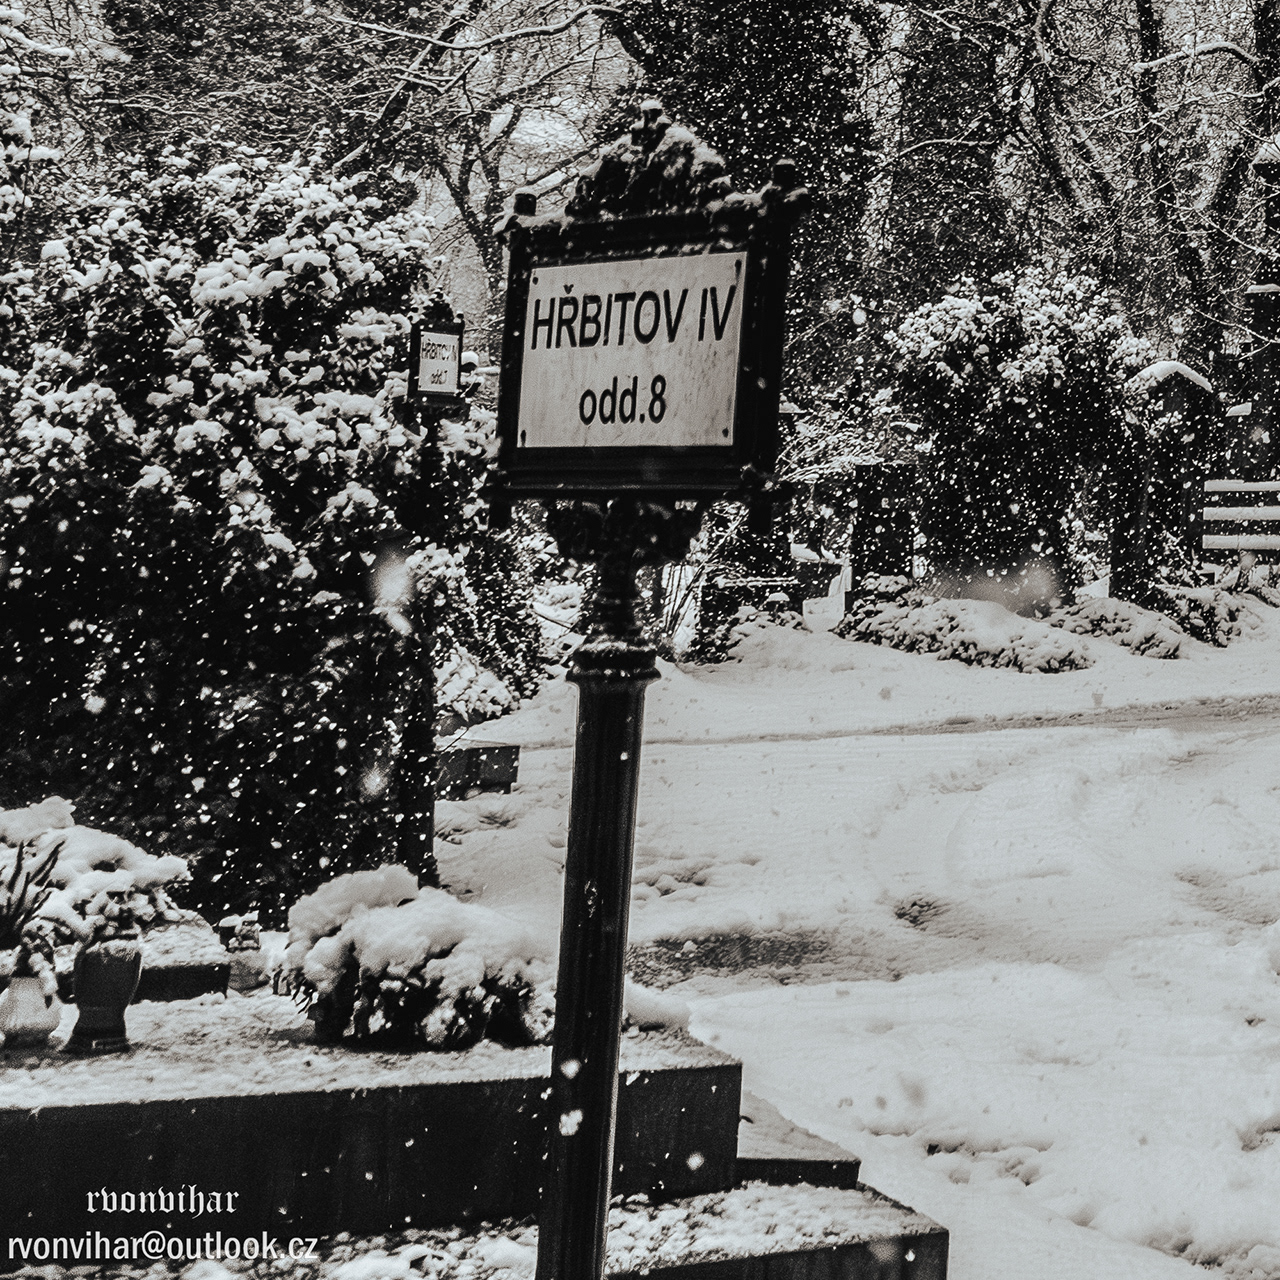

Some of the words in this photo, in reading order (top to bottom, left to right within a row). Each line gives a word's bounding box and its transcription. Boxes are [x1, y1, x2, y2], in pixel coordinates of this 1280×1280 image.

[531, 284, 689, 350] HŘBITOV
[698, 285, 737, 342] IV
[579, 374, 667, 426] odd.8
